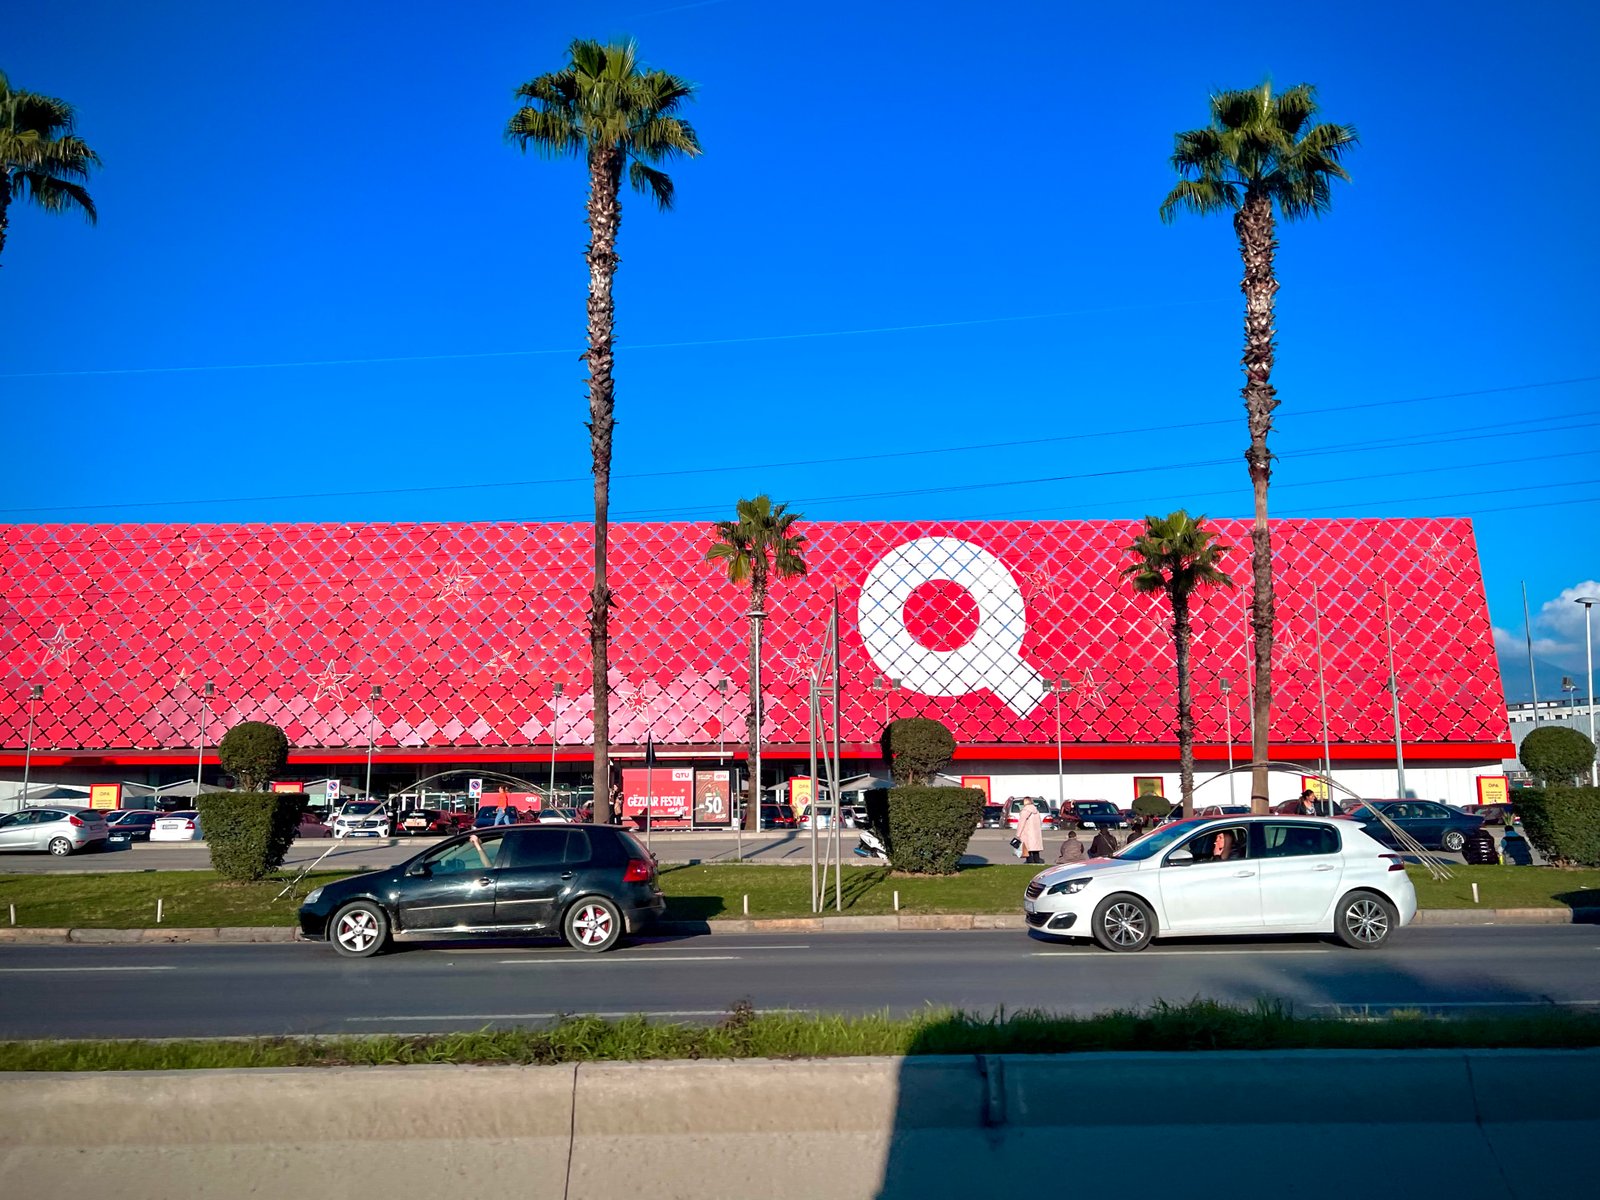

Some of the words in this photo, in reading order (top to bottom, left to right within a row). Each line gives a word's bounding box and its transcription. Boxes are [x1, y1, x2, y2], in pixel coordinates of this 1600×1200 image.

[857, 536, 1050, 720] Q
[660, 796, 685, 806] FESTAT
[704, 796, 723, 814] 50
